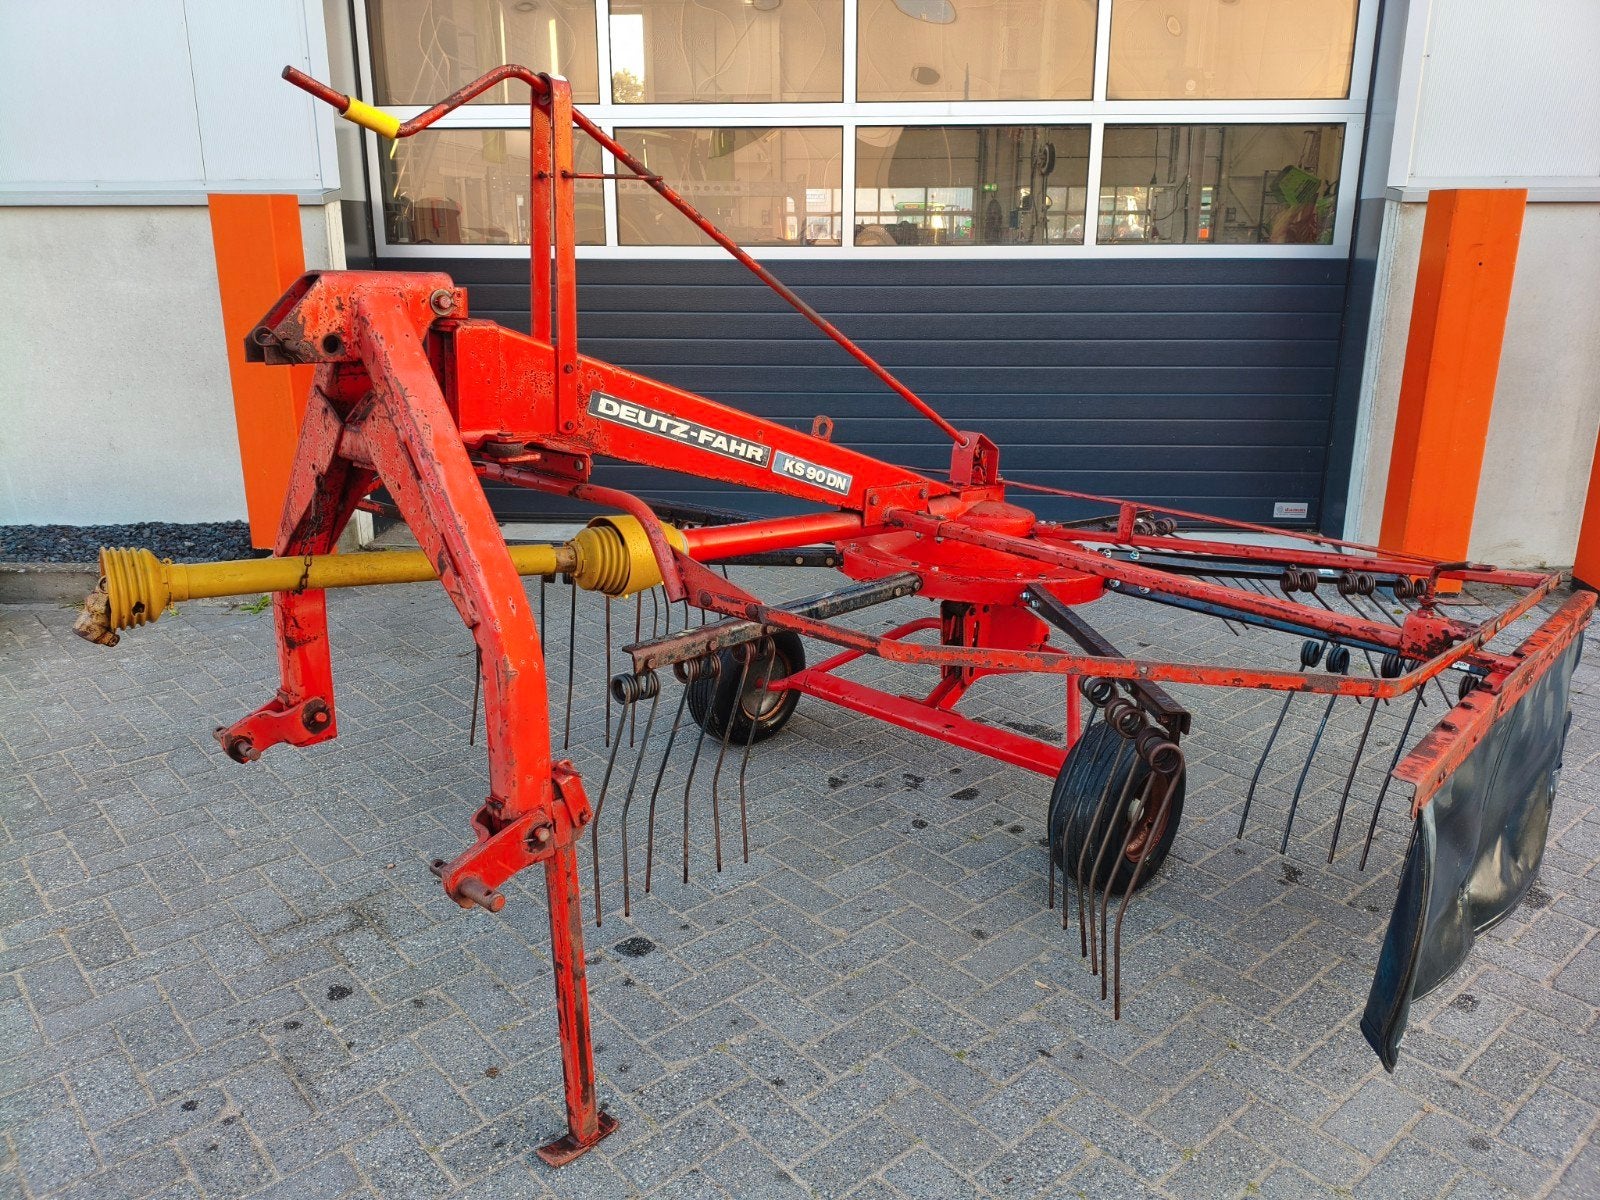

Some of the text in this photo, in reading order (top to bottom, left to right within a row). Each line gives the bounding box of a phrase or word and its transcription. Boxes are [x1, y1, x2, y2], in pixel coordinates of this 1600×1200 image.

[598, 397, 764, 462] DEUTZ-FAHR
[783, 458, 847, 490] KS 90 DN
